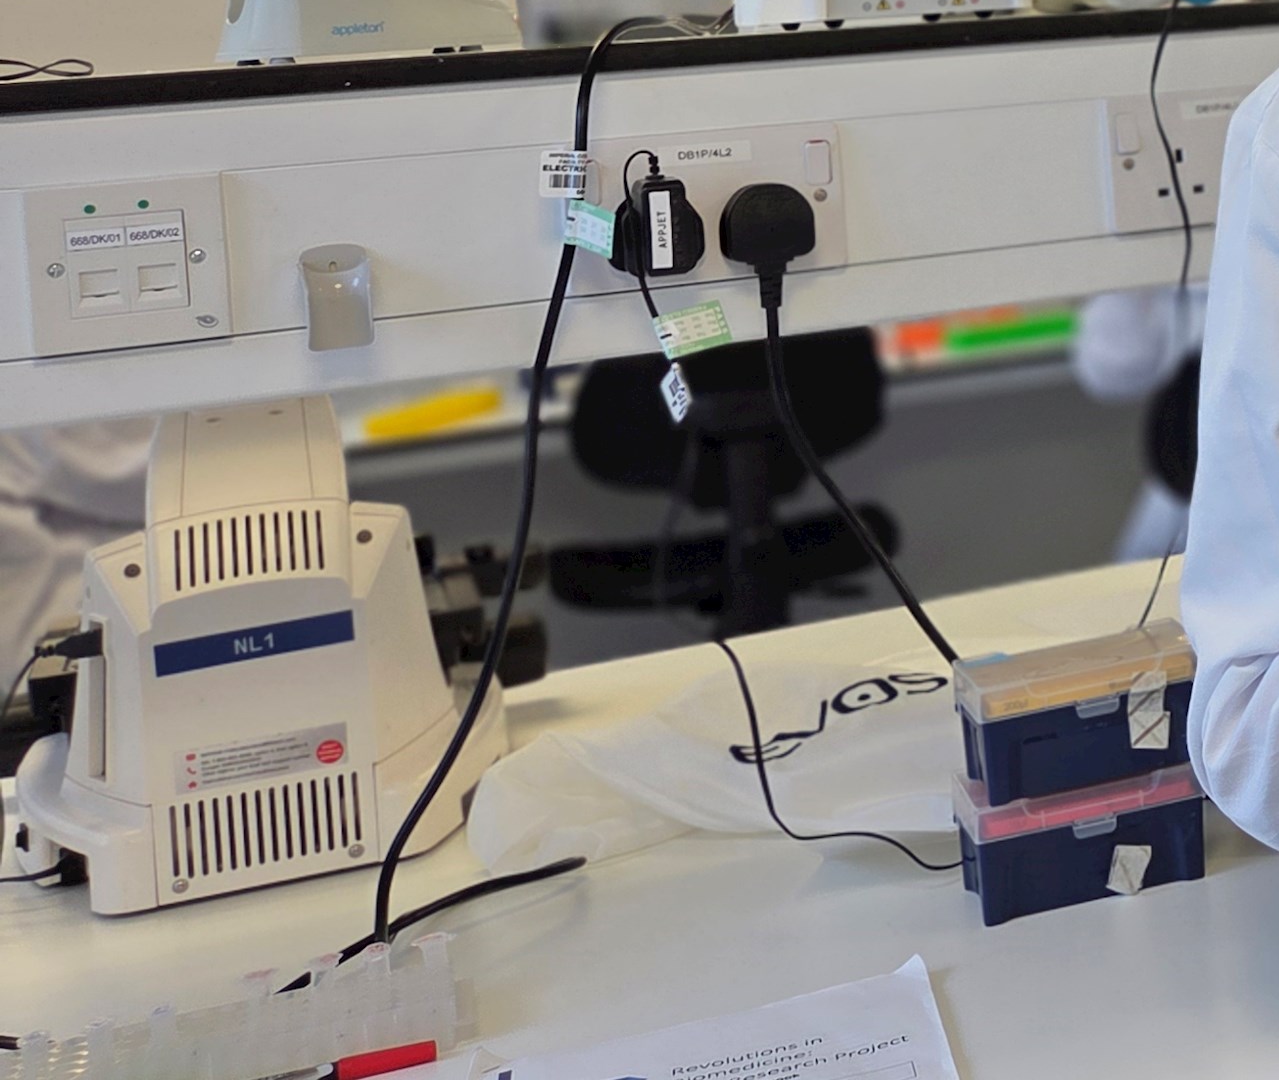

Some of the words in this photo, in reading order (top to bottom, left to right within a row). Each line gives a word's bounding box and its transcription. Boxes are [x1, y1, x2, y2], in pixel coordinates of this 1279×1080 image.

[677, 148, 732, 160] DB1P/4L2
[70, 233, 121, 247] 668/DK/01
[129, 227, 180, 241] 668/DK/02
[656, 211, 668, 249] APPJET
[234, 632, 274, 656] NL1
[672, 1042, 799, 1076] Revolutions
[804, 1035, 824, 1048] in
[835, 1034, 910, 1061] Project
